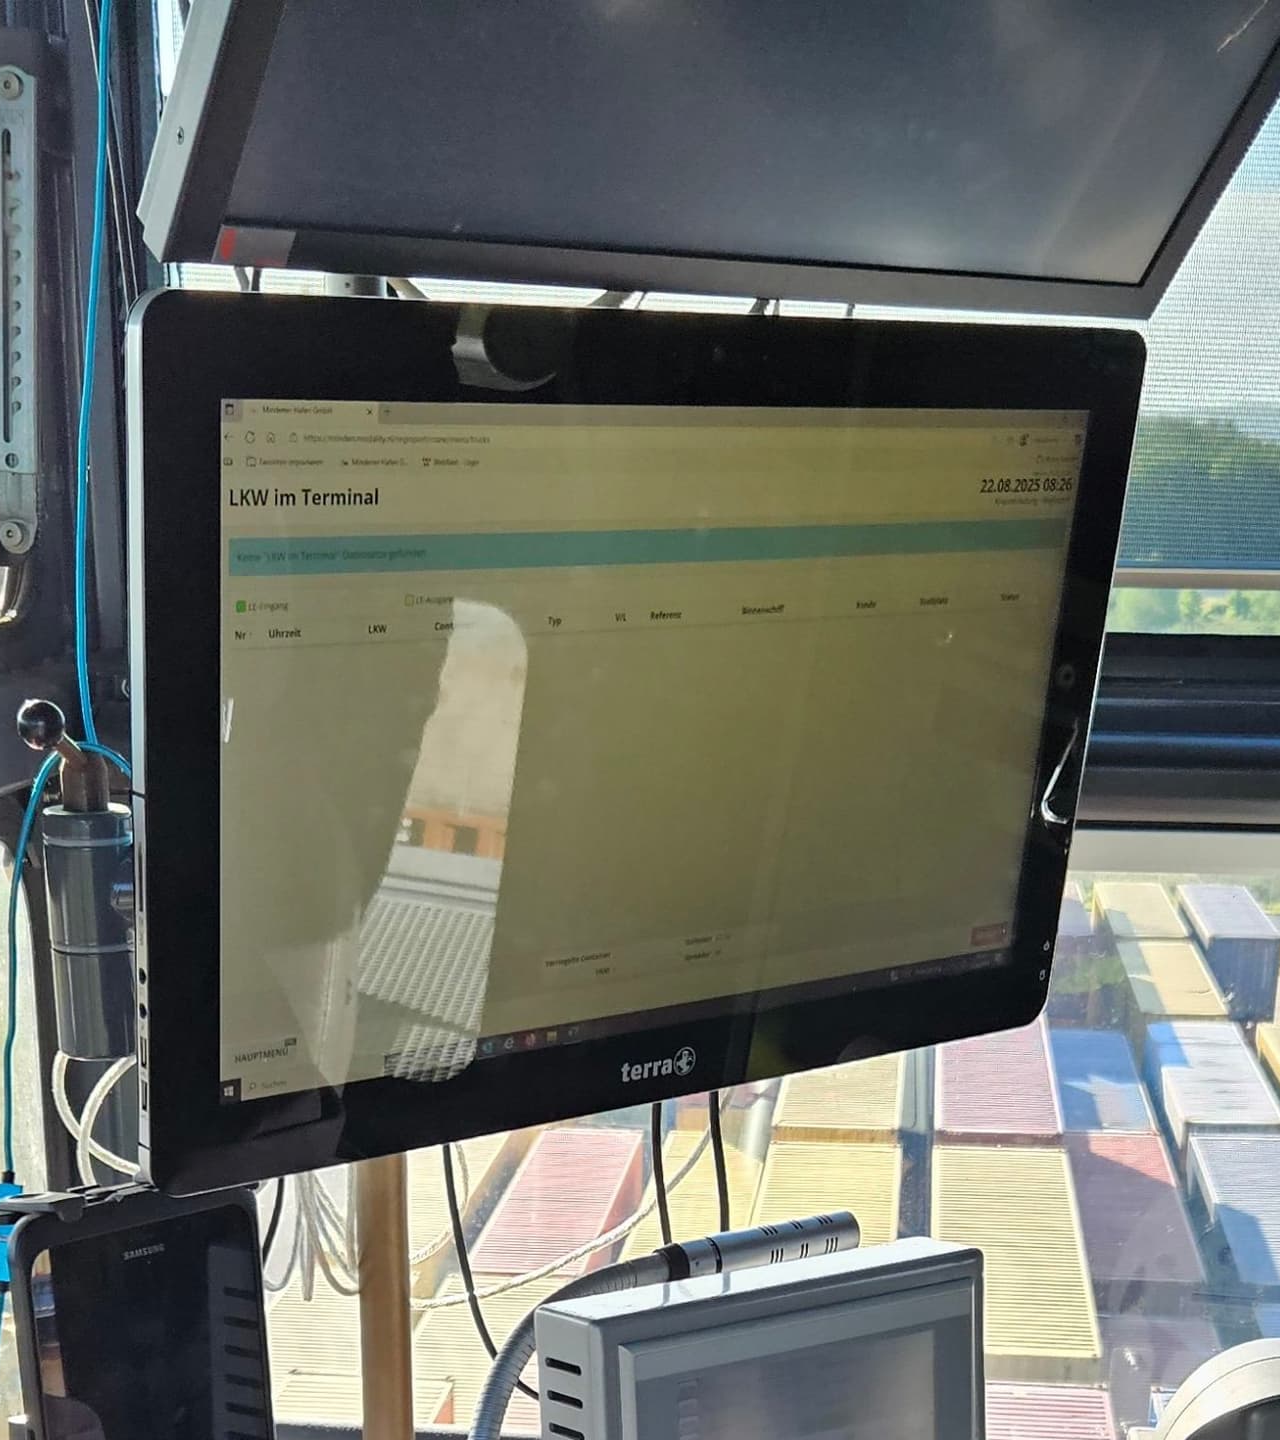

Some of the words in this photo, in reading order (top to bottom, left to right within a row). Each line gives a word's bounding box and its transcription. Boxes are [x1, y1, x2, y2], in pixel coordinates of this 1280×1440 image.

[980, 478, 1040, 494] 22.08.2025
[1043, 477, 1073, 492] 08:26
[229, 489, 268, 507] LKW
[274, 489, 296, 507] im
[302, 488, 379, 506] Terminal
[268, 627, 302, 640] Uhrzeit
[368, 623, 388, 634] LKW
[548, 615, 562, 628] Typ
[620, 1057, 673, 1083] terra
